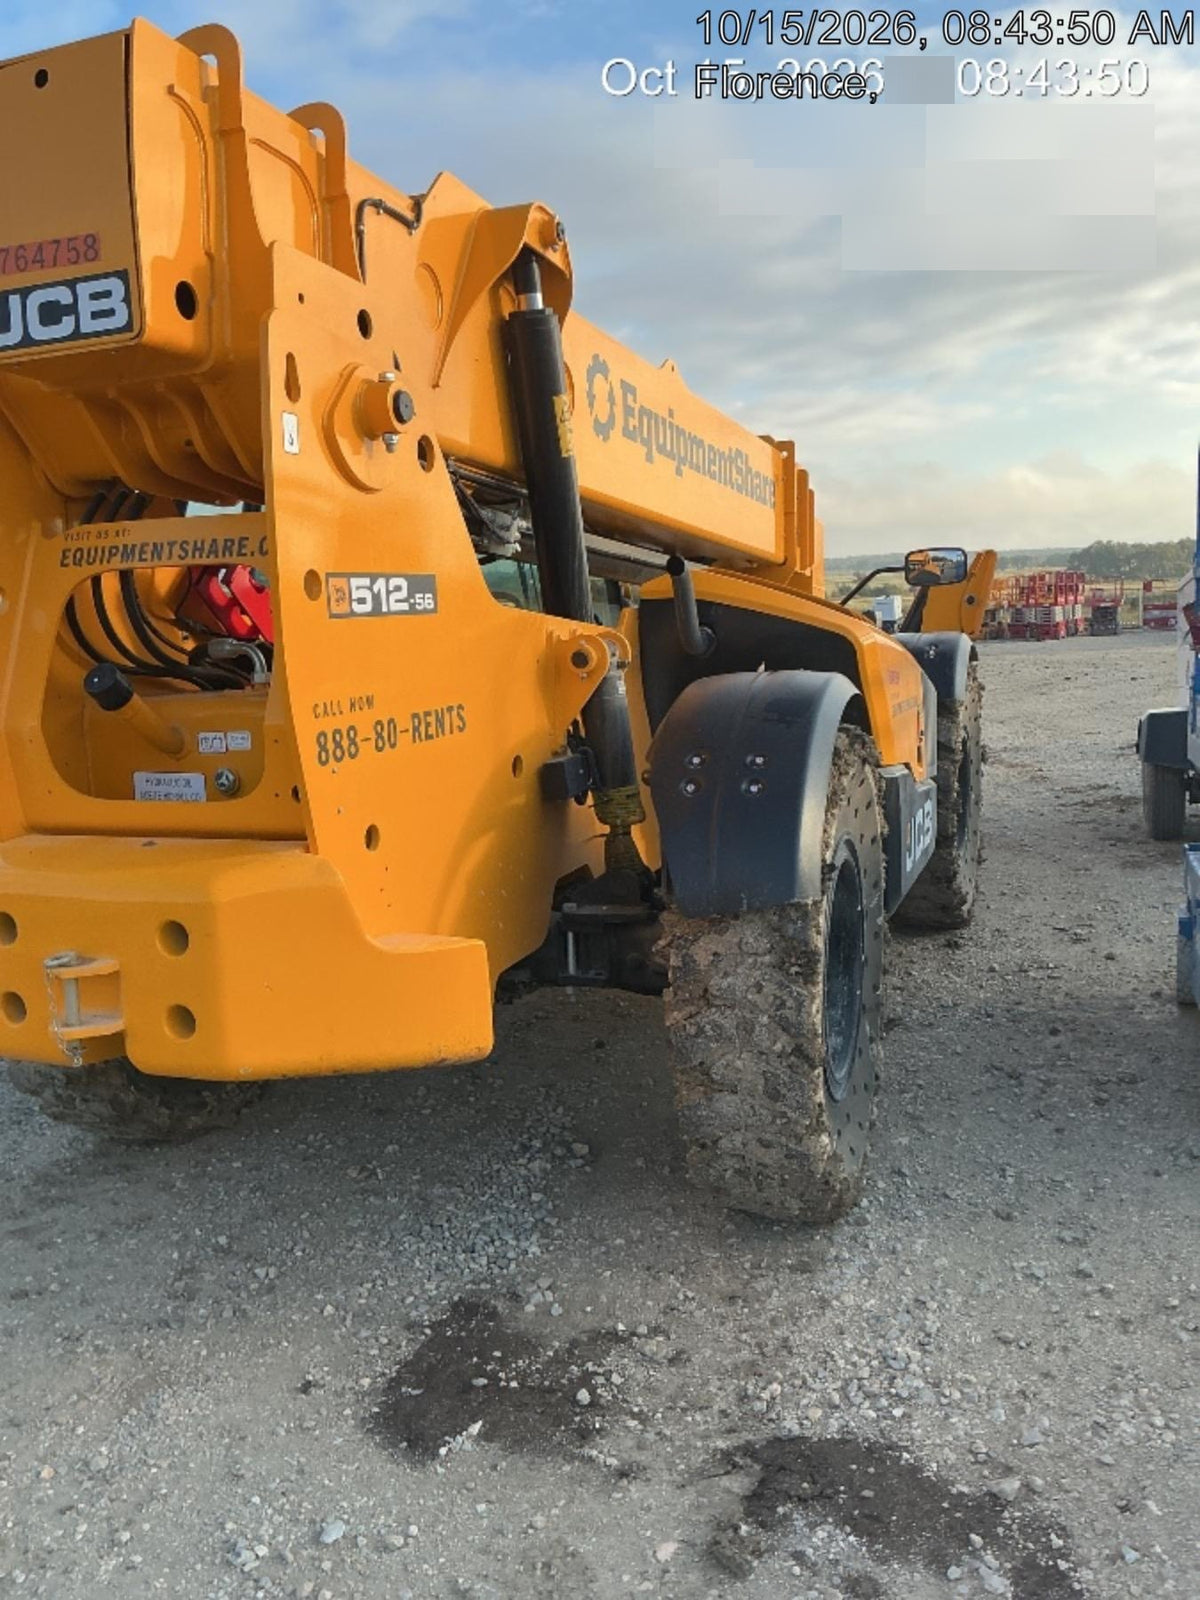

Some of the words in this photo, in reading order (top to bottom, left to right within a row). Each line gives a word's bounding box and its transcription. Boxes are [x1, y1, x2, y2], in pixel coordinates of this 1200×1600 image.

[0, 276, 129, 347] JCB
[313, 700, 344, 719] CALL
[316, 703, 467, 767] 888-80-RENTS
[906, 798, 934, 873] JCB
